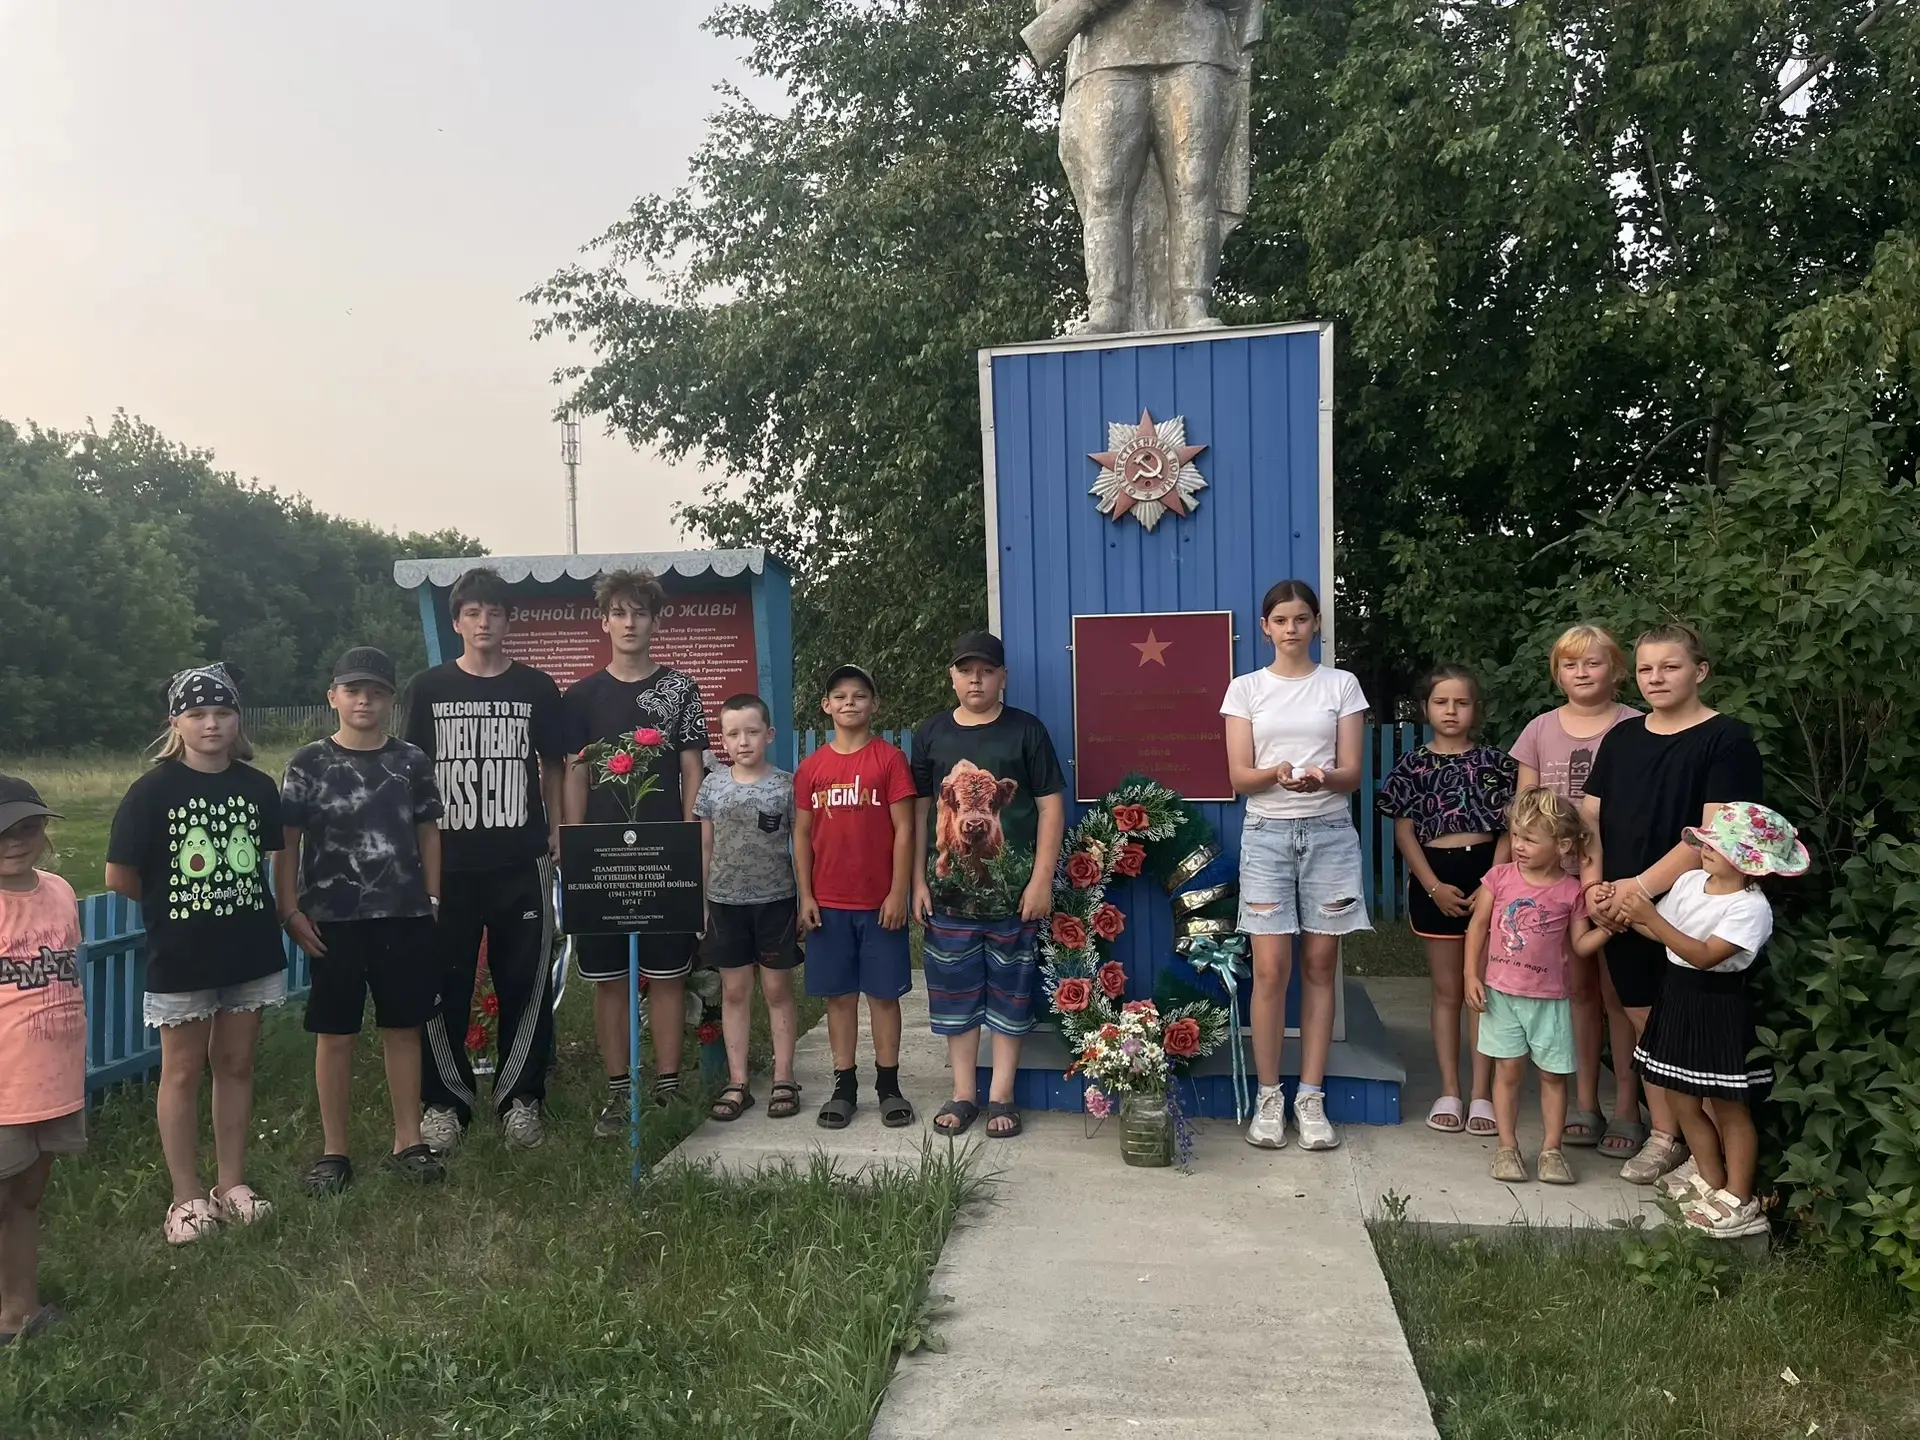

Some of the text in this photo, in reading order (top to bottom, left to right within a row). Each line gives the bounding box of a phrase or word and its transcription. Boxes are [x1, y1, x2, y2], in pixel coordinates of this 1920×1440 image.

[679, 603, 737, 617] живы
[432, 702, 532, 718] WELCOME TO THE
[434, 718, 530, 760] LOVELY HEARTS
[482, 759, 528, 829] CLUB
[811, 775, 881, 819] ORIGINAL
[567, 879, 698, 890] ВЕЛИКОЙ ОТЕЧЕСТВЕННОЙ ВОЙНЫ»
[594, 874, 637, 882] ПОГИБШИМ
[644, 873, 665, 881] ГОДЫ
[179, 891, 199, 901] You
[201, 887, 248, 900] Complete
[622, 898, 636, 906] 1974
[1524, 964, 1548, 974] magic
